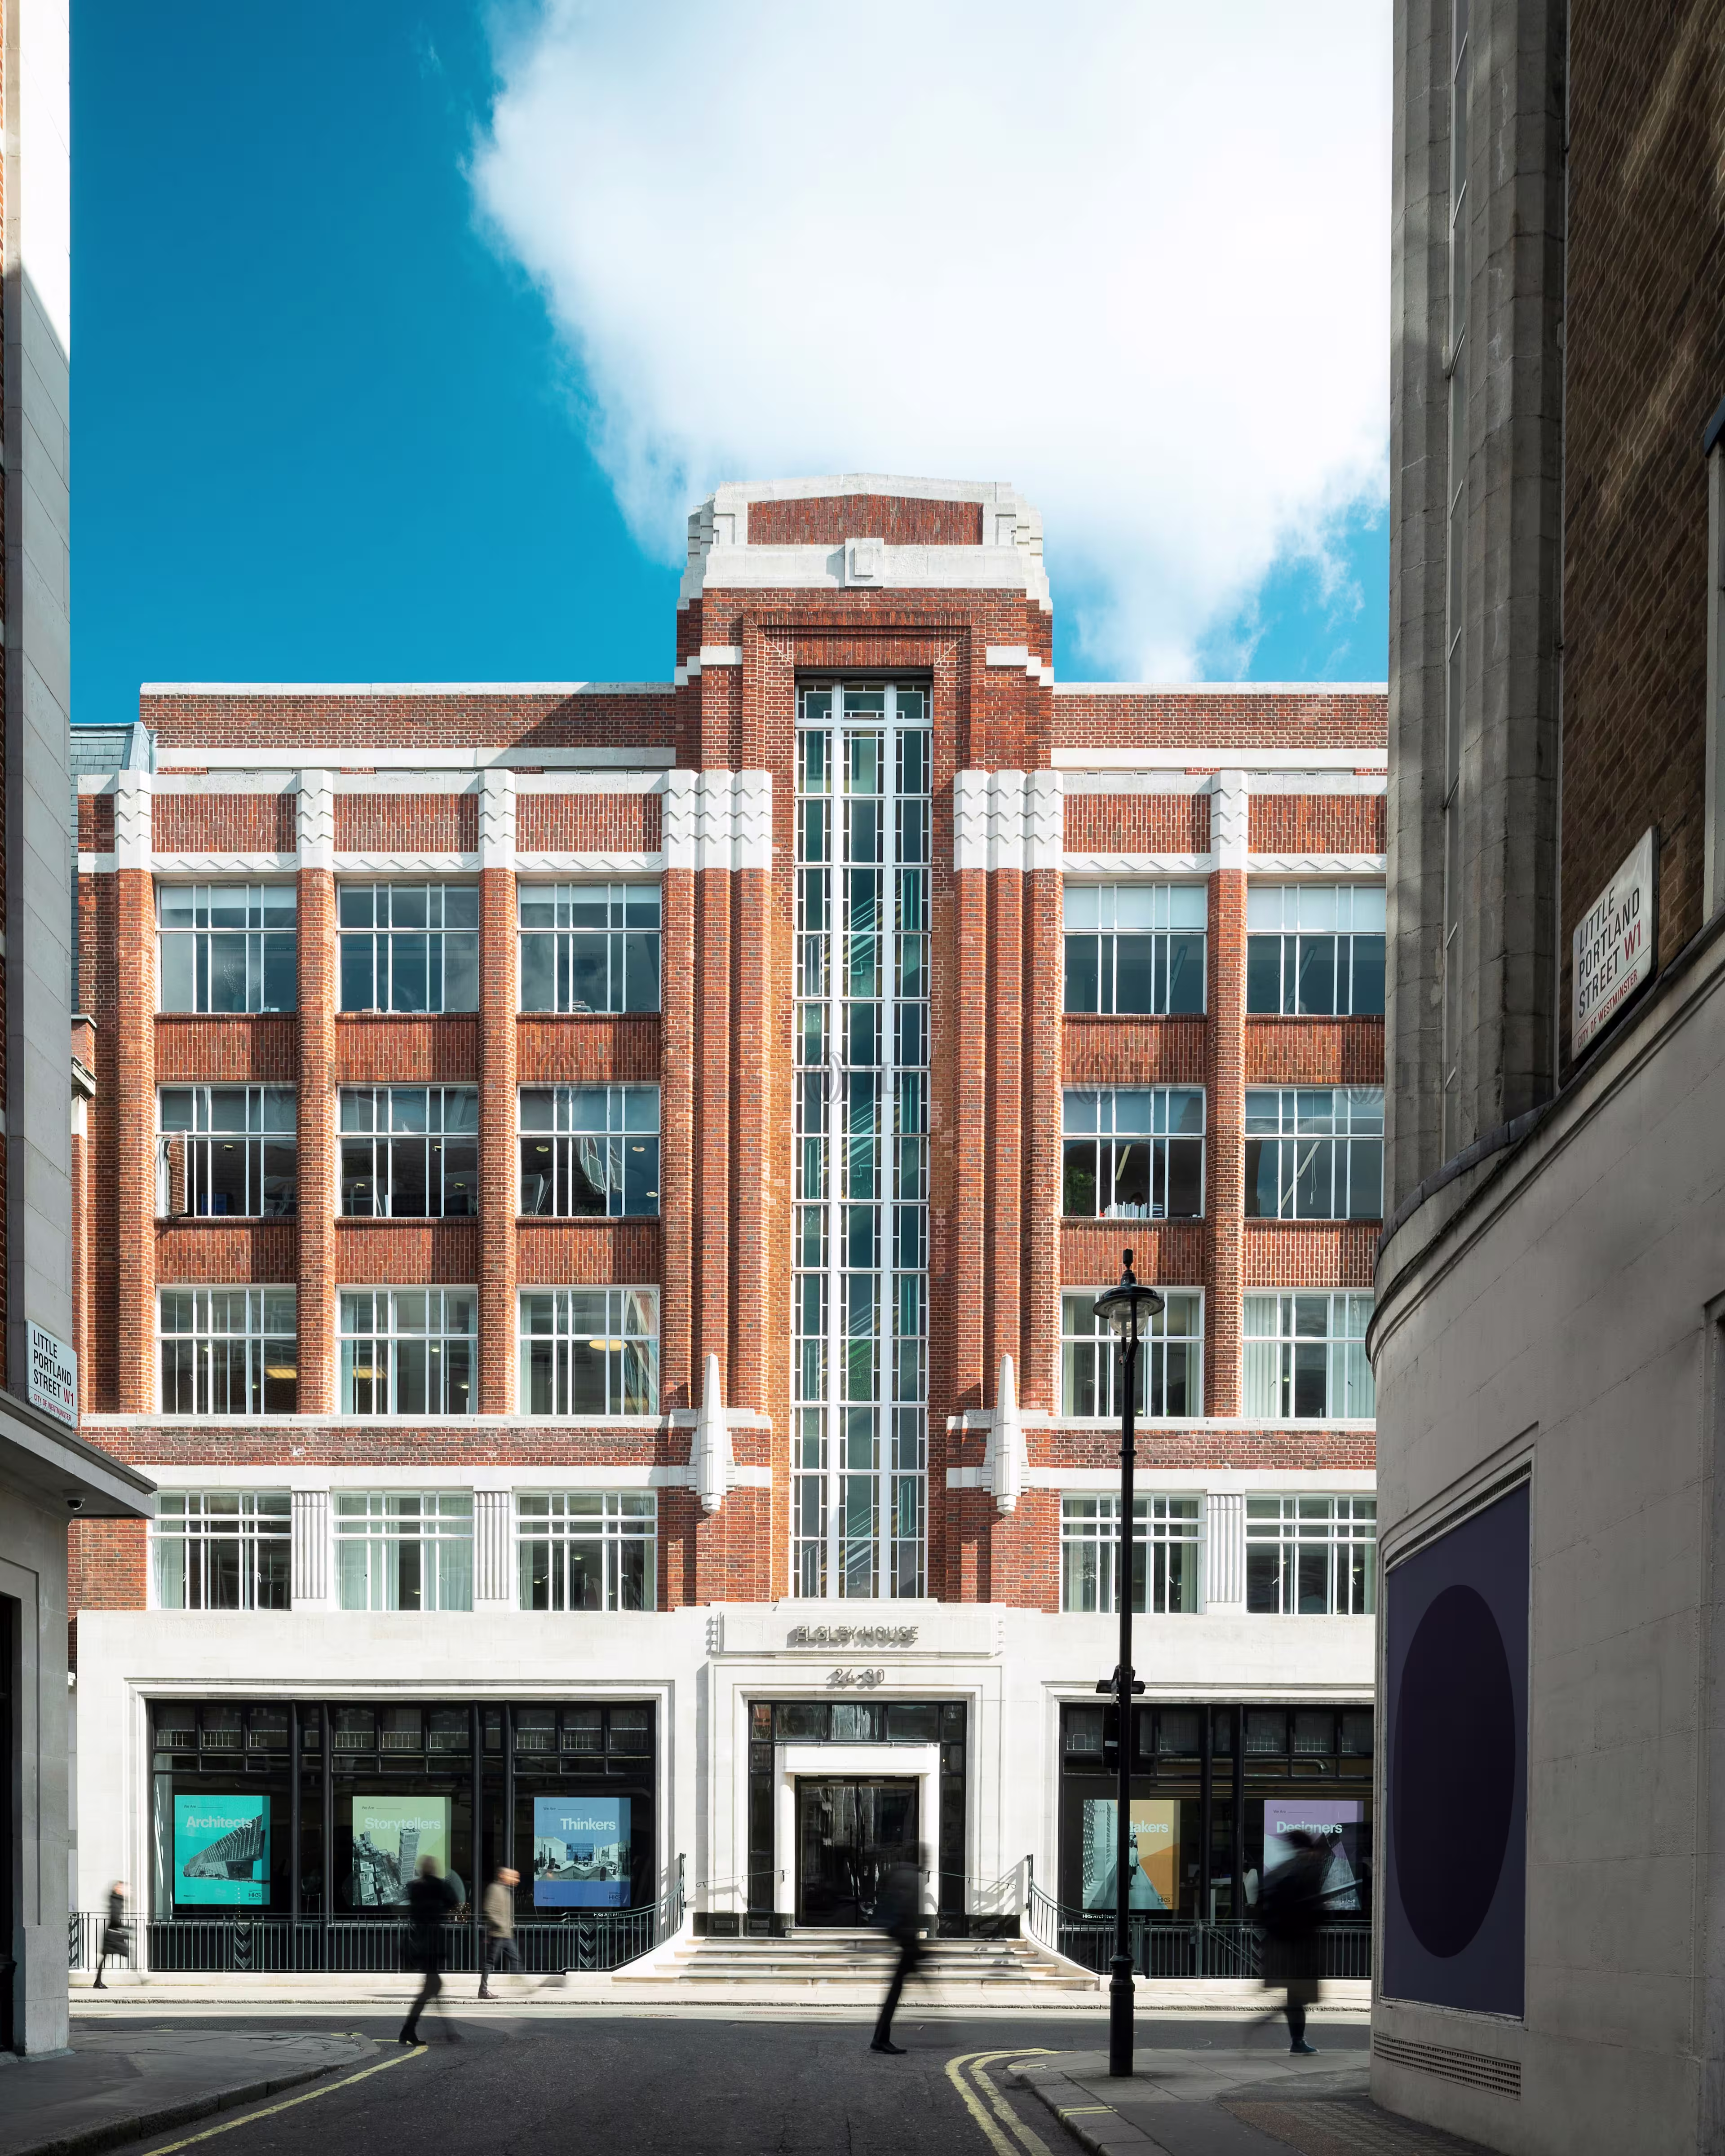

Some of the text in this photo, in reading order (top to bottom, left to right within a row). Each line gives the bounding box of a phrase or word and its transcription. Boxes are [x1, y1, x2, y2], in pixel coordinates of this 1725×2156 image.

[1580, 886, 1614, 954] LITTLE
[1579, 888, 1639, 987] PORTLAND
[1579, 919, 1641, 1018] STREET W1
[1578, 969, 1637, 1048] CITY OF WESTMINSTER
[33, 1330, 58, 1359] LITTLE
[34, 1349, 71, 1387] PORTLAND
[34, 1369, 74, 1407] STREET W1
[34, 1394, 71, 1421] CITY OF WESTMINSTER
[796, 1626, 919, 1640] ELSLEY HOUSE
[186, 1816, 253, 1828] Architects
[365, 1817, 441, 1831] Storytellers
[560, 1818, 616, 1830] Thinkers
[1277, 1821, 1343, 1834] Designers
